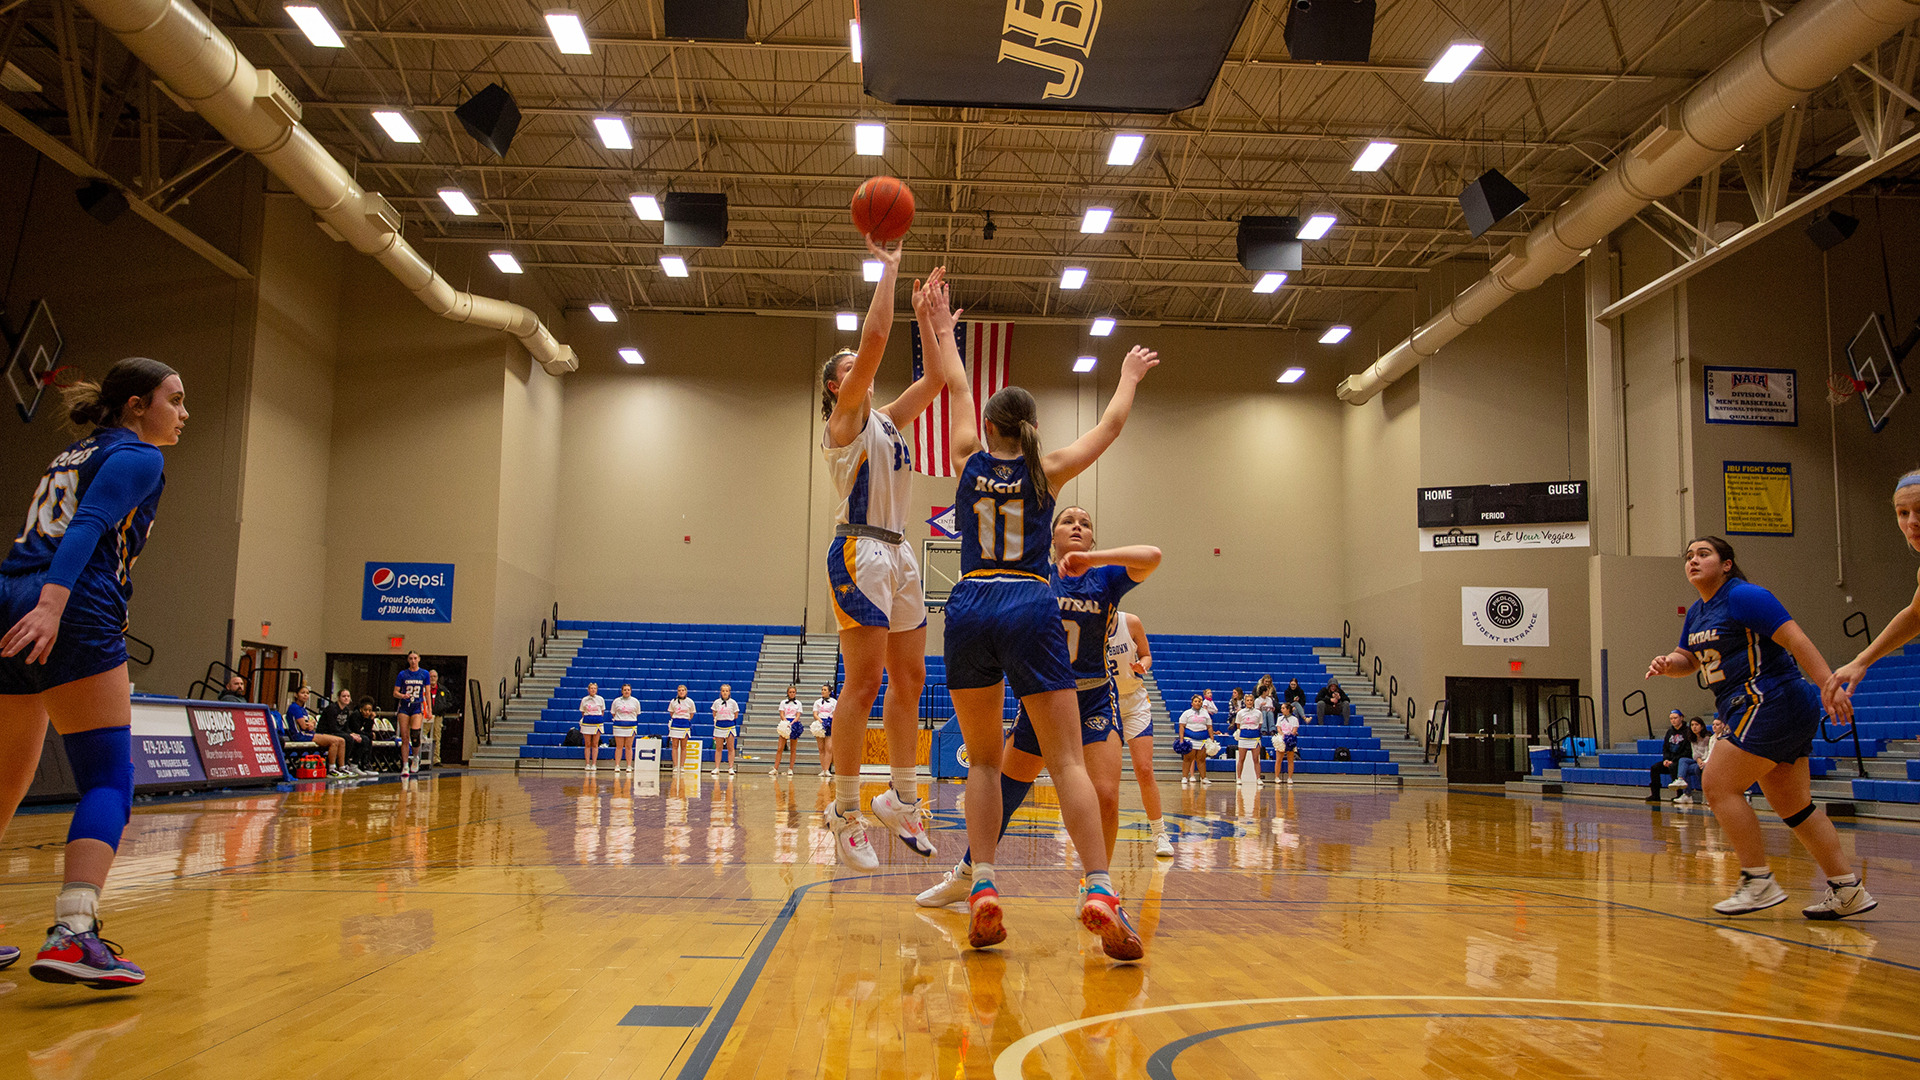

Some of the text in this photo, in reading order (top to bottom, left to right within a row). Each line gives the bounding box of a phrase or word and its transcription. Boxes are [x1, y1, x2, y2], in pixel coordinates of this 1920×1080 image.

[1732, 373, 1768, 390] NAIA
[974, 475, 1022, 494] RICH
[1548, 483, 1581, 495] GUEST
[1424, 490, 1452, 500] HOME
[1481, 512, 1505, 520] PERIOD
[973, 497, 1024, 561] 11
[1435, 535, 1477, 545] SAGER CREEK
[1493, 530, 1576, 544] Eat Your Veggies
[397, 572, 444, 589] pepsi
[380, 594, 436, 606] Proud Sponsor
[377, 605, 436, 616] of JBU Athletics
[1501, 605, 1509, 614] P
[1472, 611, 1538, 643] STUDENT ENTRANCE
[406, 685, 421, 698] 22
[250, 733, 271, 746] SIGNS
[255, 753, 277, 764] DESIGN
[639, 748, 656, 761] U
[259, 764, 281, 774] BANNERS
